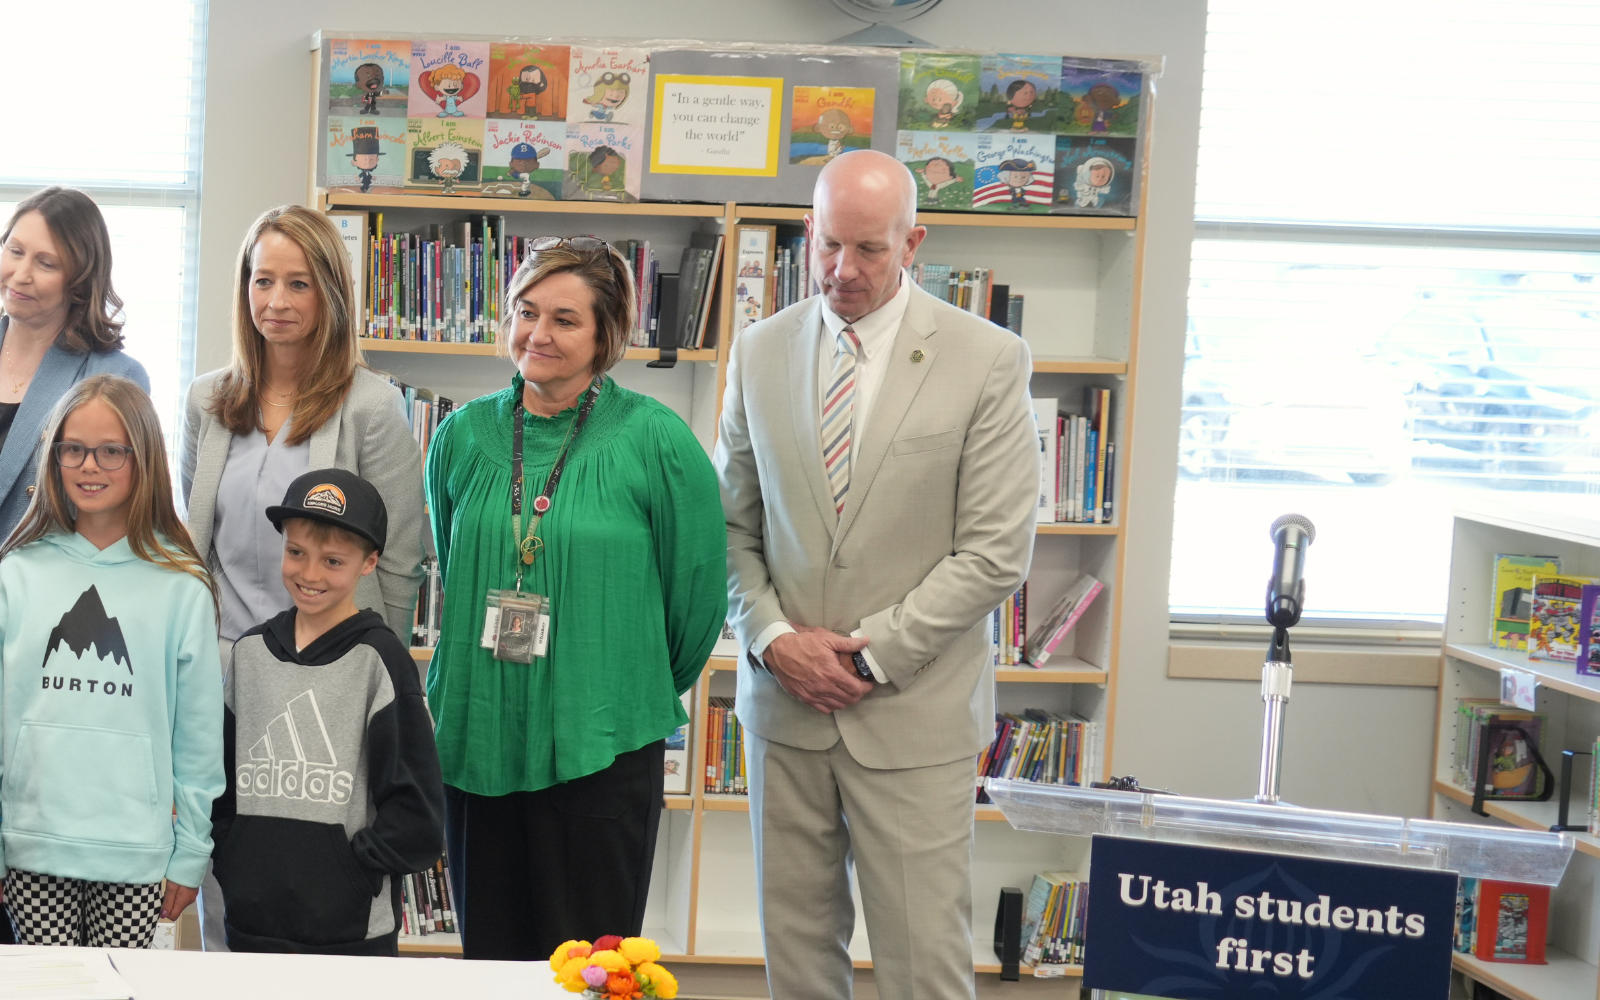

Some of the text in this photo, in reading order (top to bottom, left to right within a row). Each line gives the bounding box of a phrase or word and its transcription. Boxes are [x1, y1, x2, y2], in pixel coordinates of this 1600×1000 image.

[332, 54, 359, 70] Martin
[359, 50, 386, 61] Luther
[420, 52, 483, 70] Lucille Ball
[575, 57, 646, 75] Amelia Earhart
[702, 94, 736, 107] gentle
[740, 98, 765, 109] way,
[816, 96, 855, 109] Gandhi
[672, 113, 760, 126] you can change
[329, 127, 406, 147] Abraham Lincoln
[413, 129, 483, 148] Albert Einstein
[492, 130, 562, 150] Jackie Robinson
[580, 133, 631, 150] Rosa Parks
[685, 129, 704, 140] the
[908, 143, 969, 159] Helen Keller
[977, 151, 1007, 164] George
[1082, 148, 1132, 170] Armstrong
[341, 219, 348, 228] B
[42, 676, 133, 697] BURTON
[236, 758, 353, 804] adidas
[1118, 872, 1426, 938] Utah students
[1216, 937, 1315, 978] first
